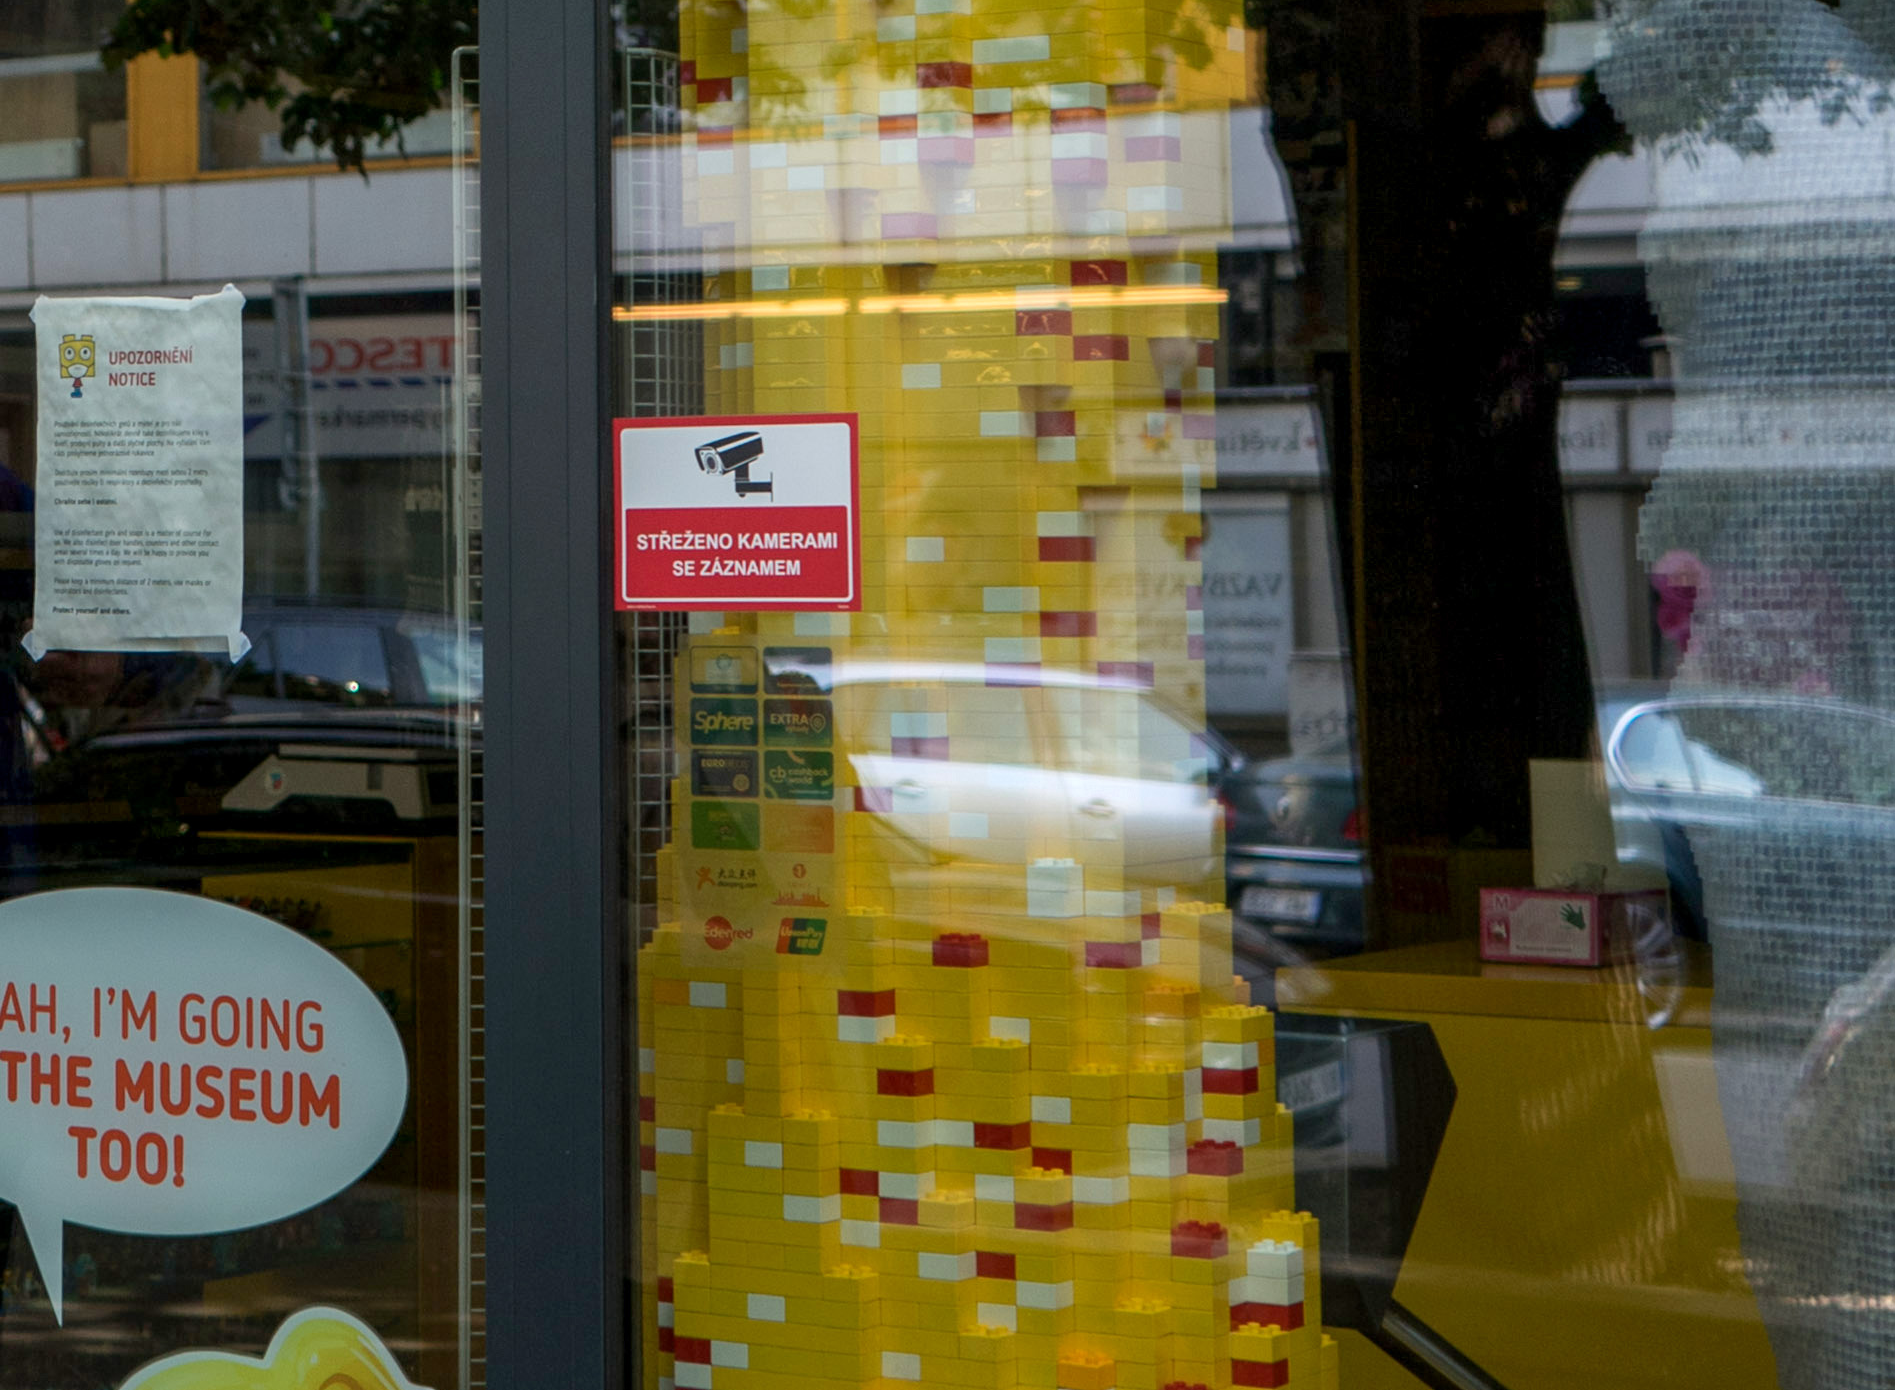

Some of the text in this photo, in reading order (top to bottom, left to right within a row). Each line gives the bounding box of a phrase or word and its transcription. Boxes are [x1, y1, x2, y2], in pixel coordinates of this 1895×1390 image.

[107, 345, 194, 366] UPOZORNĚNÍ
[107, 371, 157, 387] NOTICE
[635, 530, 839, 551] STŘEŽENO KAMERAMI
[671, 555, 802, 577] SE ZÁZNAMEM
[693, 710, 755, 734] Sphere
[769, 713, 810, 725] EXTRA
[703, 924, 754, 940] Edenred
[178, 992, 324, 1053] GOING
[113, 1057, 342, 1130] MUSEUM
[67, 1125, 186, 1189] TOO!
